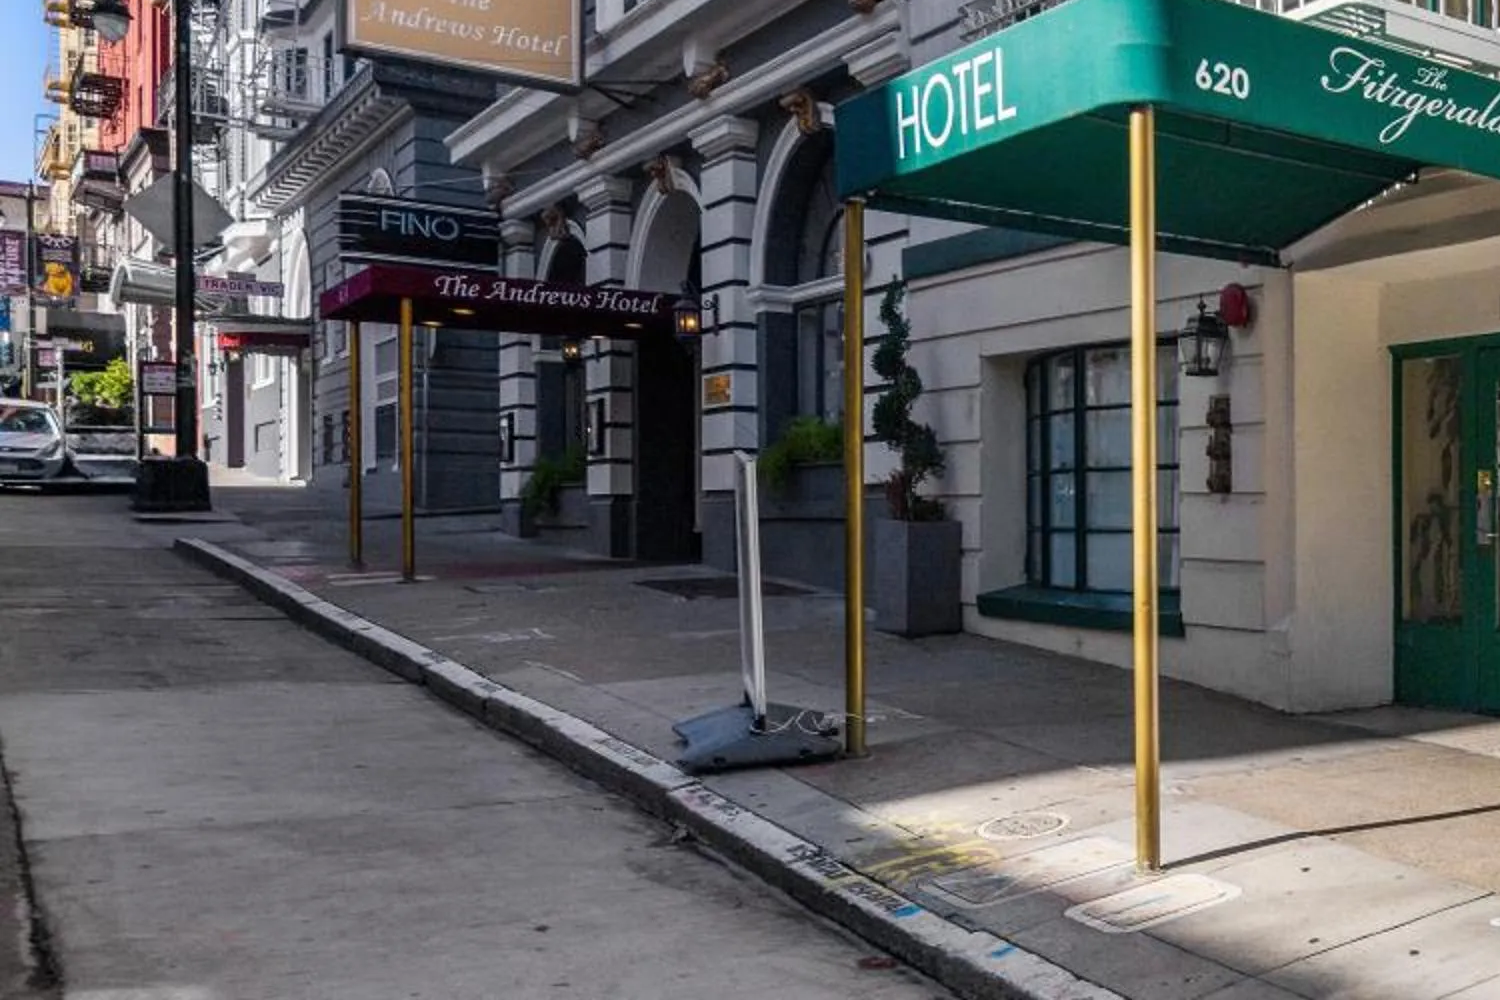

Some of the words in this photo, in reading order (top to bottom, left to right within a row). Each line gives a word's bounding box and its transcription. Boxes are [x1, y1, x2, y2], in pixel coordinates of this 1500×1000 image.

[360, 0, 486, 42] Andrews
[491, 24, 569, 58] Hotel
[1194, 58, 1251, 100] 620
[1411, 65, 1450, 92] The
[895, 47, 1018, 160] HOTEL
[379, 208, 460, 242] FINO
[433, 275, 481, 299] The
[483, 280, 592, 309] Andrews
[595, 291, 660, 314] Hotel
